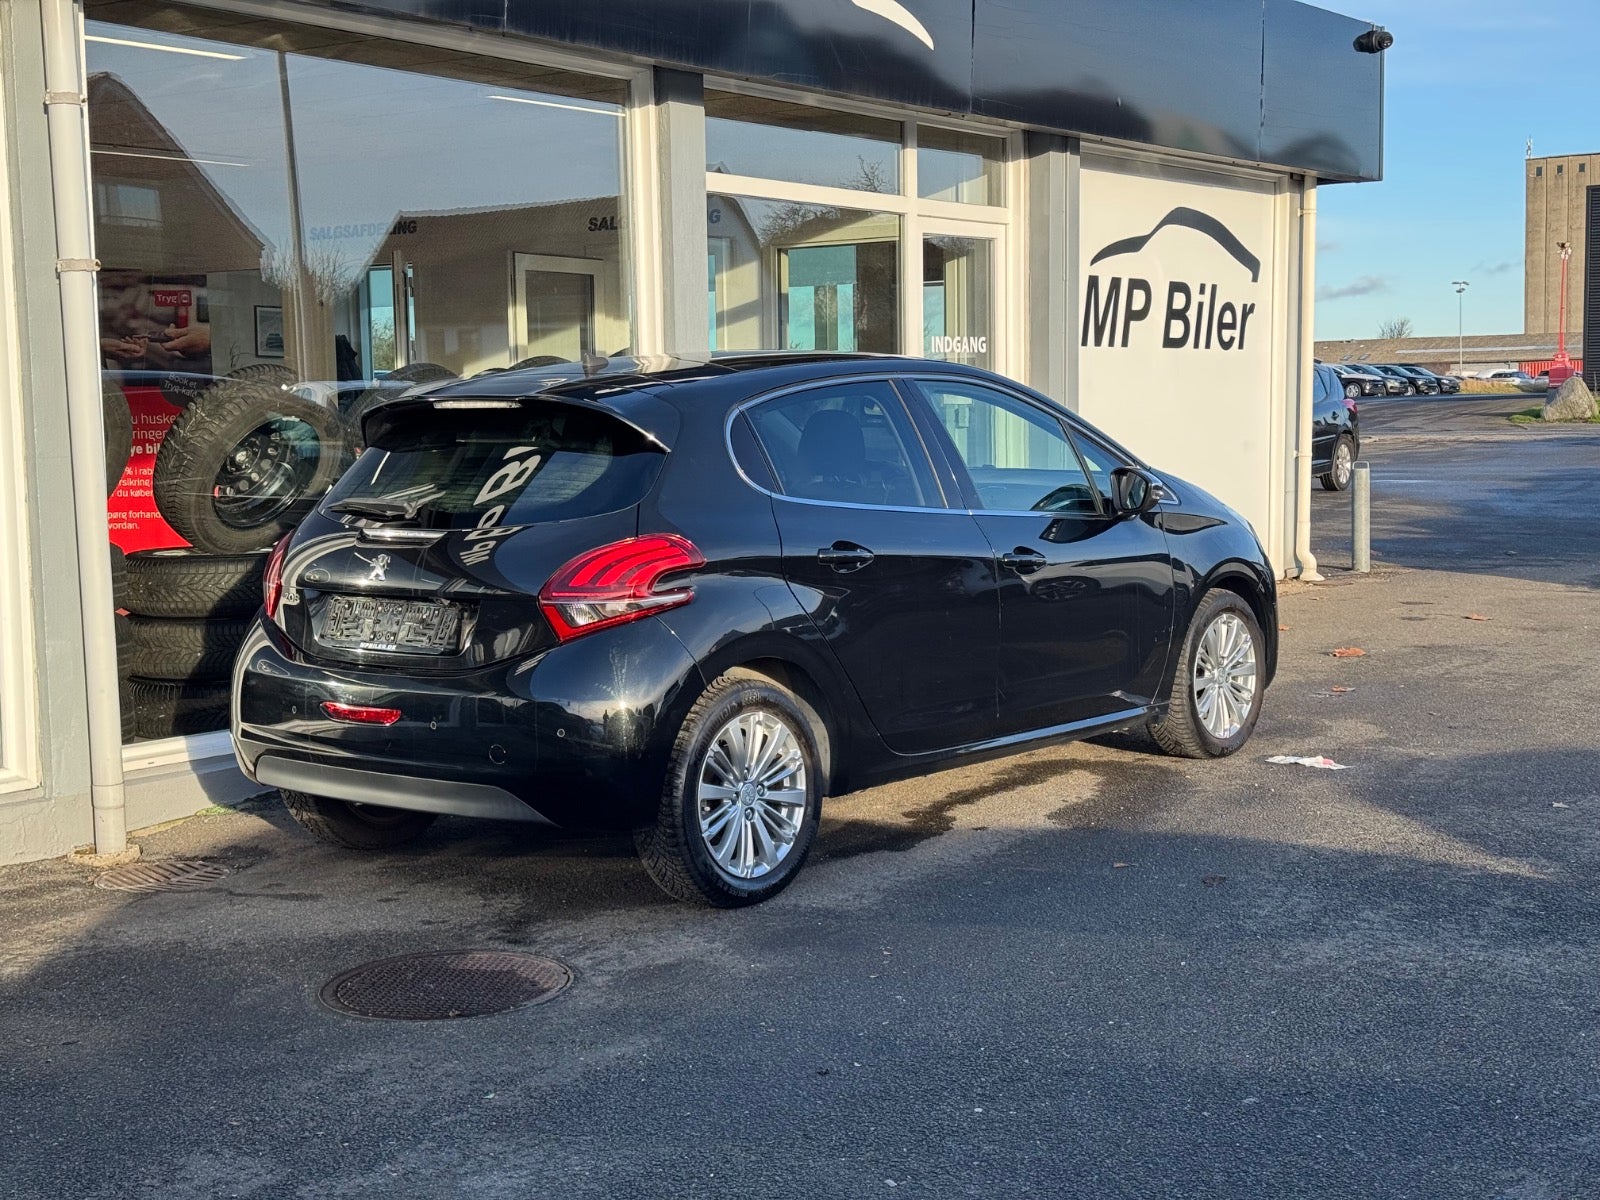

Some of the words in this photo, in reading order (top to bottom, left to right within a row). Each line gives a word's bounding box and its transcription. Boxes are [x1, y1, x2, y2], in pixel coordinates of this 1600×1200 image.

[157, 294, 177, 304] Tryg
[1081, 275, 1152, 348] MP
[1162, 281, 1256, 351] Biler
[931, 335, 987, 354] INDGANG
[168, 373, 188, 386] Book
[140, 412, 178, 425] huske
[130, 444, 143, 457] ye
[139, 466, 153, 476] rab
[119, 477, 151, 487] rsikring
[116, 488, 129, 497] du
[108, 511, 128, 520] pørg
[108, 521, 140, 530] vordan.
[284, 592, 300, 604] 208
